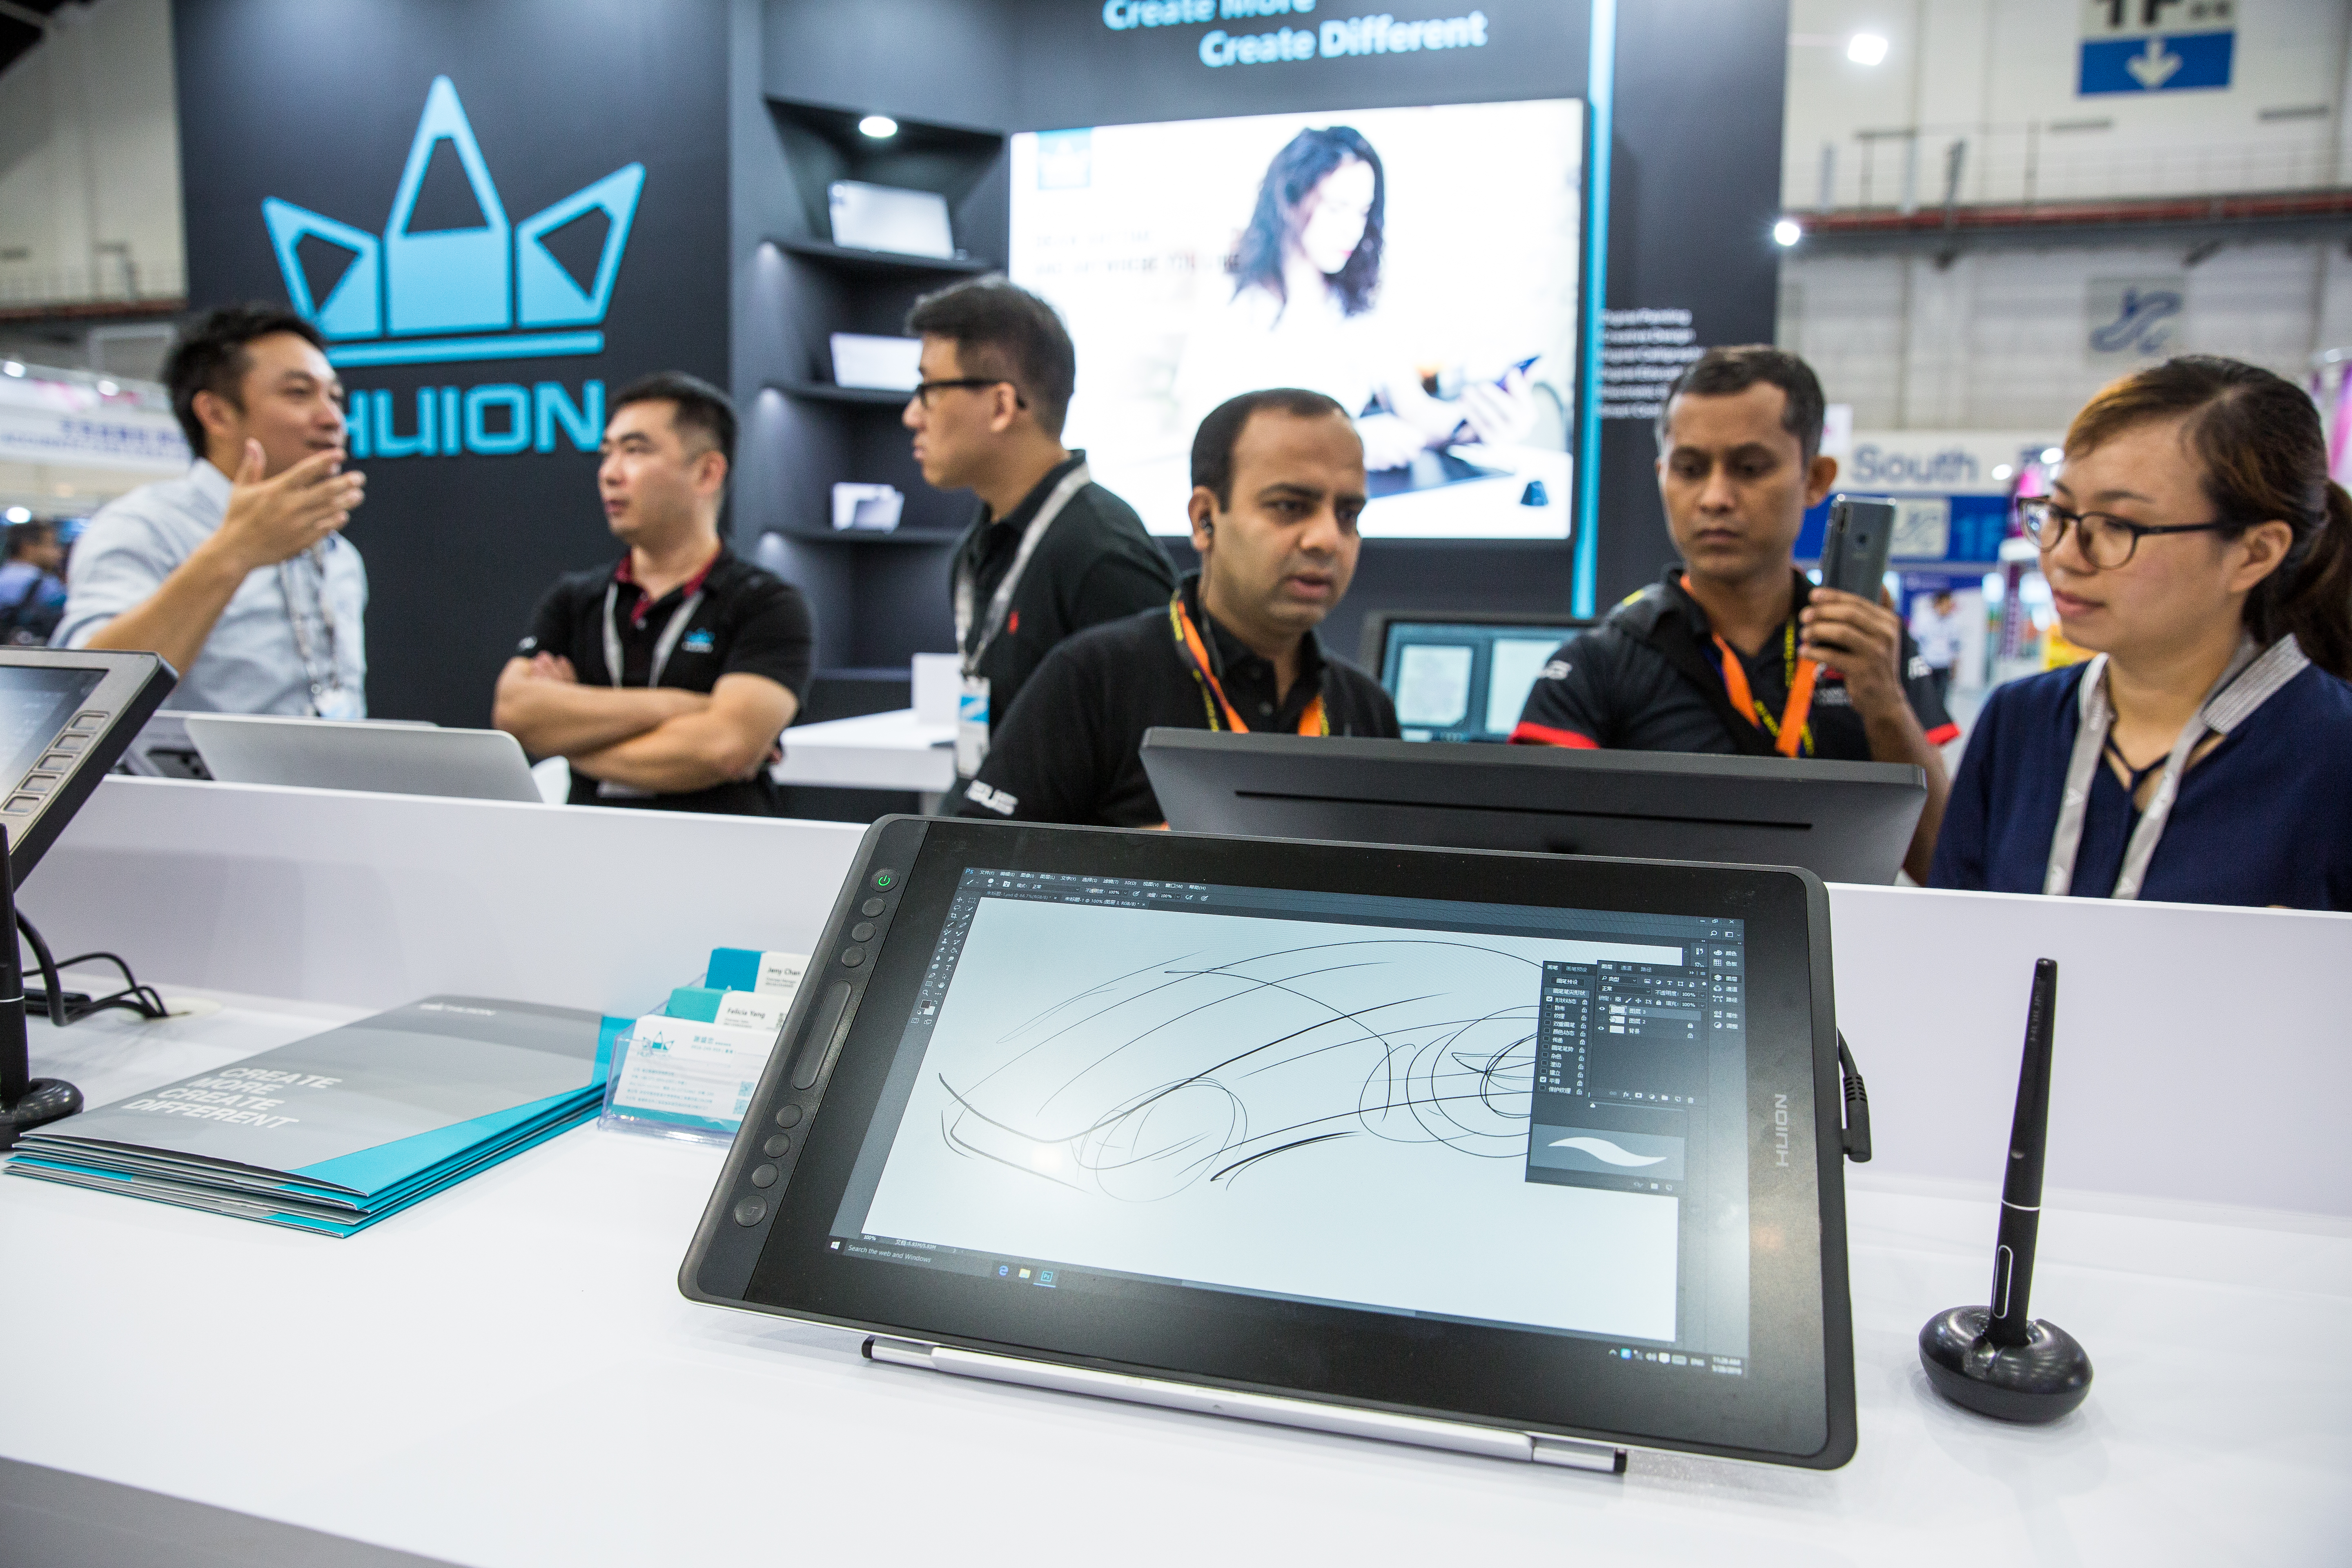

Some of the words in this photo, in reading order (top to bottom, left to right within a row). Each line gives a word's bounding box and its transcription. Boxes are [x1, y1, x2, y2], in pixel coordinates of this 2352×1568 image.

[1199, 27, 1317, 68] Create
[1319, 10, 1488, 58] Different
[1851, 443, 1980, 484] South
[185, 1077, 284, 1095] MORE
[219, 1067, 343, 1089] CREATE
[157, 1087, 285, 1111] CREATE
[121, 1098, 299, 1128] DIFFERENT
[1775, 1094, 1789, 1167] HUION
[905, 1254, 931, 1263] Windows
